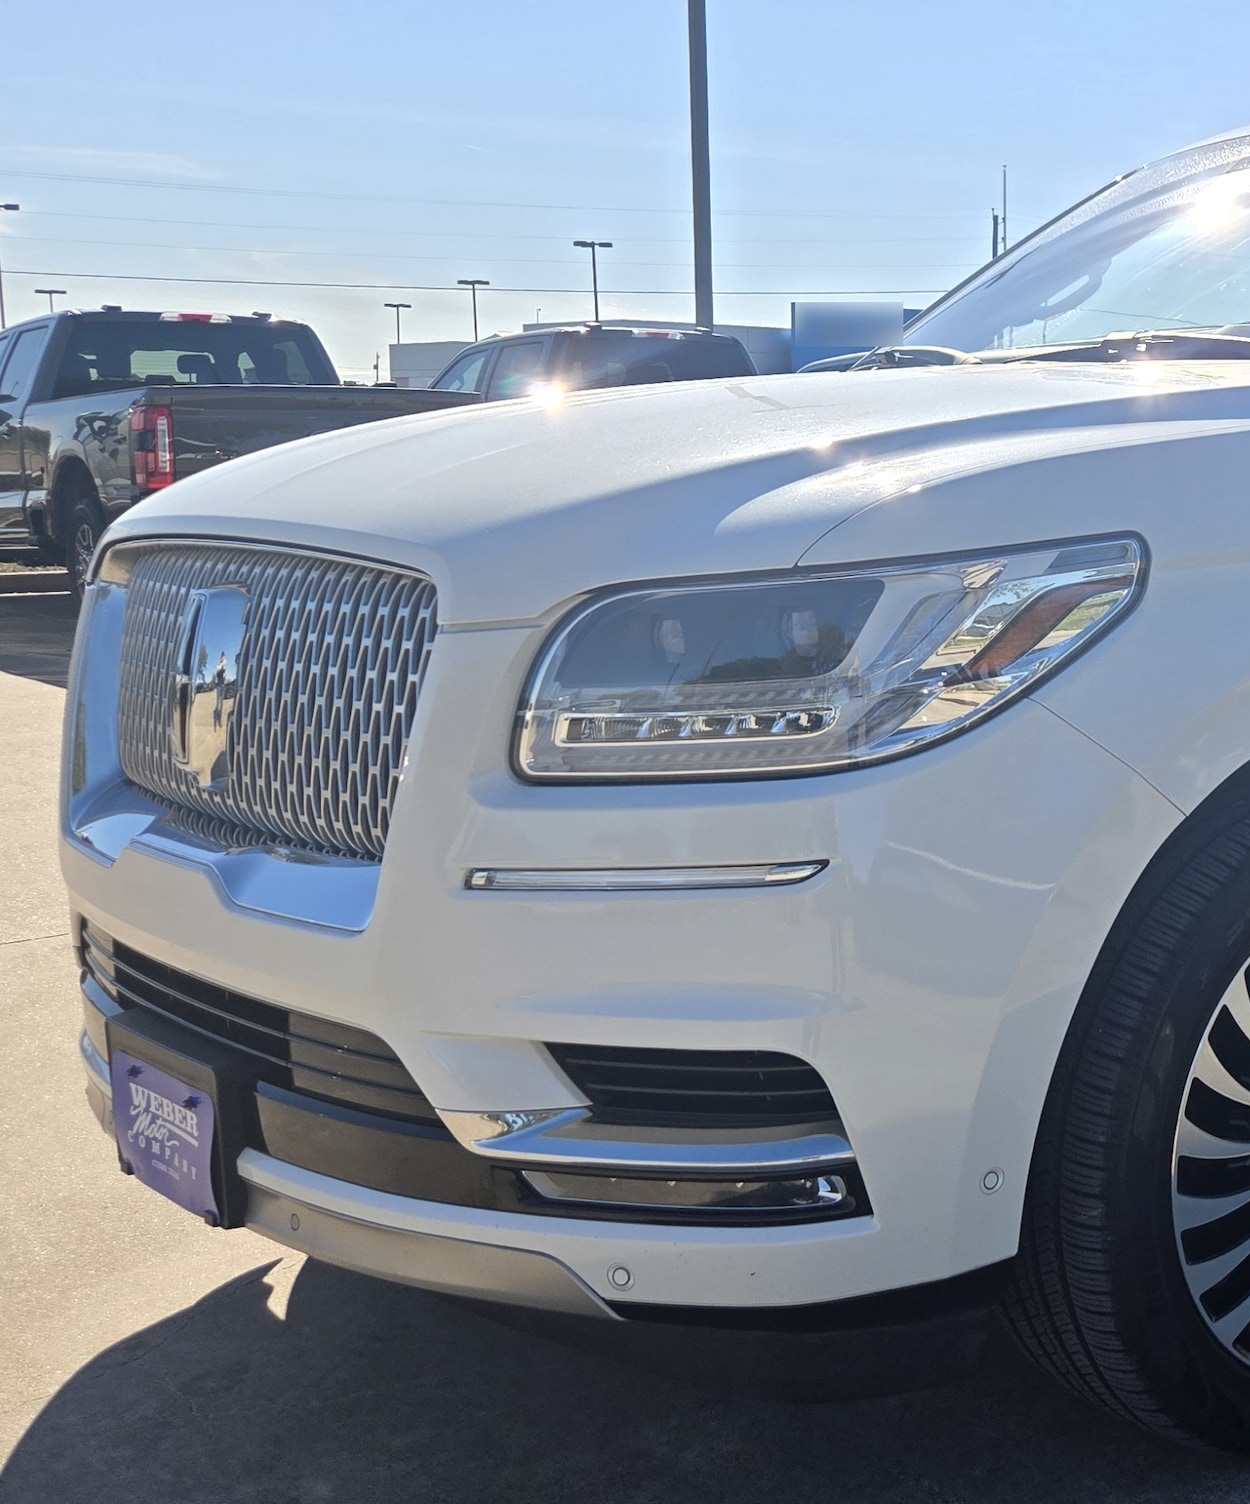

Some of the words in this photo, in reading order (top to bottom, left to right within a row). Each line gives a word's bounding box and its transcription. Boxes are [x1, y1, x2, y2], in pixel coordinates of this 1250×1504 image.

[129, 1083, 198, 1134] WEBER
[130, 1105, 180, 1147] Motor
[128, 1130, 197, 1180] COMPANY
